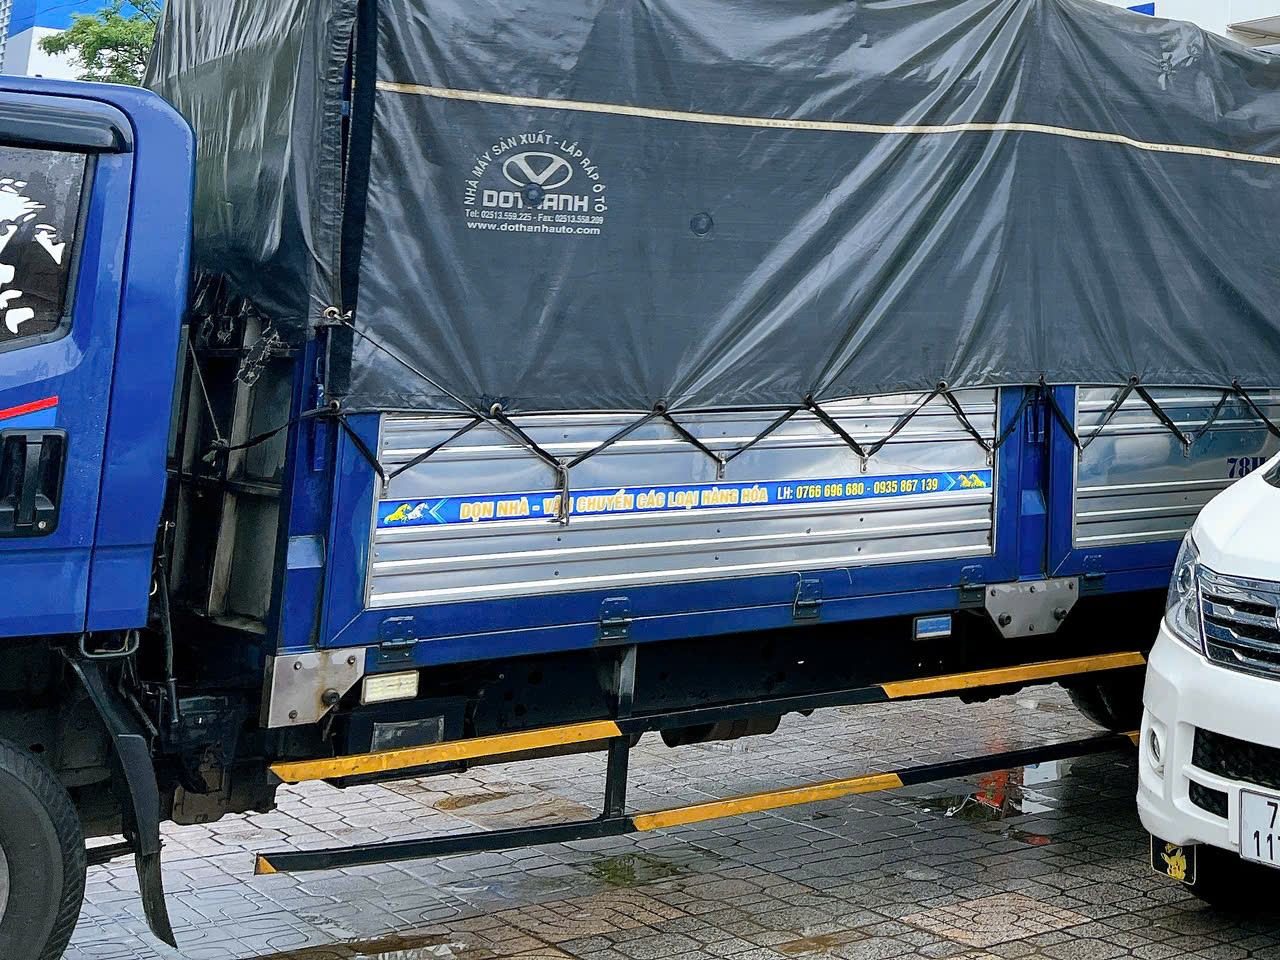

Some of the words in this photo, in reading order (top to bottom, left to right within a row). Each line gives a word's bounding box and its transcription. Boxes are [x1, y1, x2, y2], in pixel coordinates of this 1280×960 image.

[519, 129, 553, 145] XUẤT
[471, 151, 493, 177] MÁY
[580, 157, 600, 181] RÁP
[464, 179, 479, 205] NHÀ
[592, 183, 606, 193] Ô
[482, 189, 589, 212] DOTANH
[594, 195, 608, 213] TÔ
[465, 208, 480, 218] Tel:
[466, 222, 601, 235] www.dothanhauto.com
[460, 501, 494, 522] DỌN
[496, 496, 530, 518] NHÀ
[577, 489, 635, 513] CHUYỂN
[636, 489, 666, 509] CÁC
[668, 490, 699, 511] LOẠI
[702, 486, 739, 506] HÀNG
[740, 483, 769, 504] HÓA
[777, 486, 794, 500] LH:
[796, 484, 821, 499] 0766
[824, 483, 843, 497] 696
[845, 482, 865, 496] 680
[873, 480, 898, 495] 0935
[900, 478, 918, 493] 867
[921, 477, 939, 491] 139
